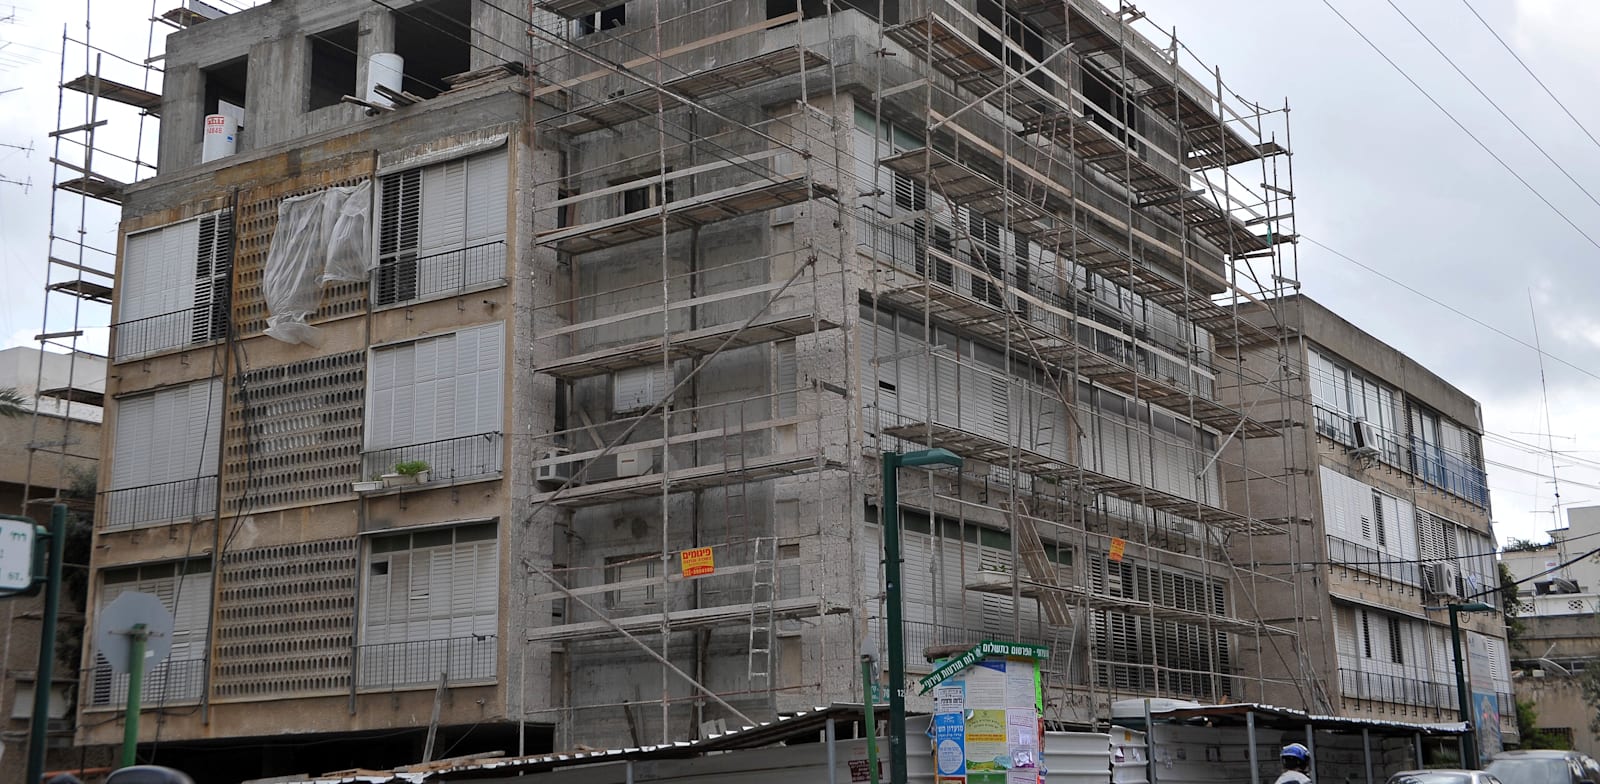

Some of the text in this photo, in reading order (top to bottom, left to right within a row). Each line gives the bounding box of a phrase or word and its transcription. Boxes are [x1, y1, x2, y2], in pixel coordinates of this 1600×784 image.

[682, 548, 711, 560] פיגומים
[982, 642, 1009, 654] בתשלום
[1011, 646, 1032, 656] הפרסום
[924, 652, 975, 688] לוח מודעות עירוני
